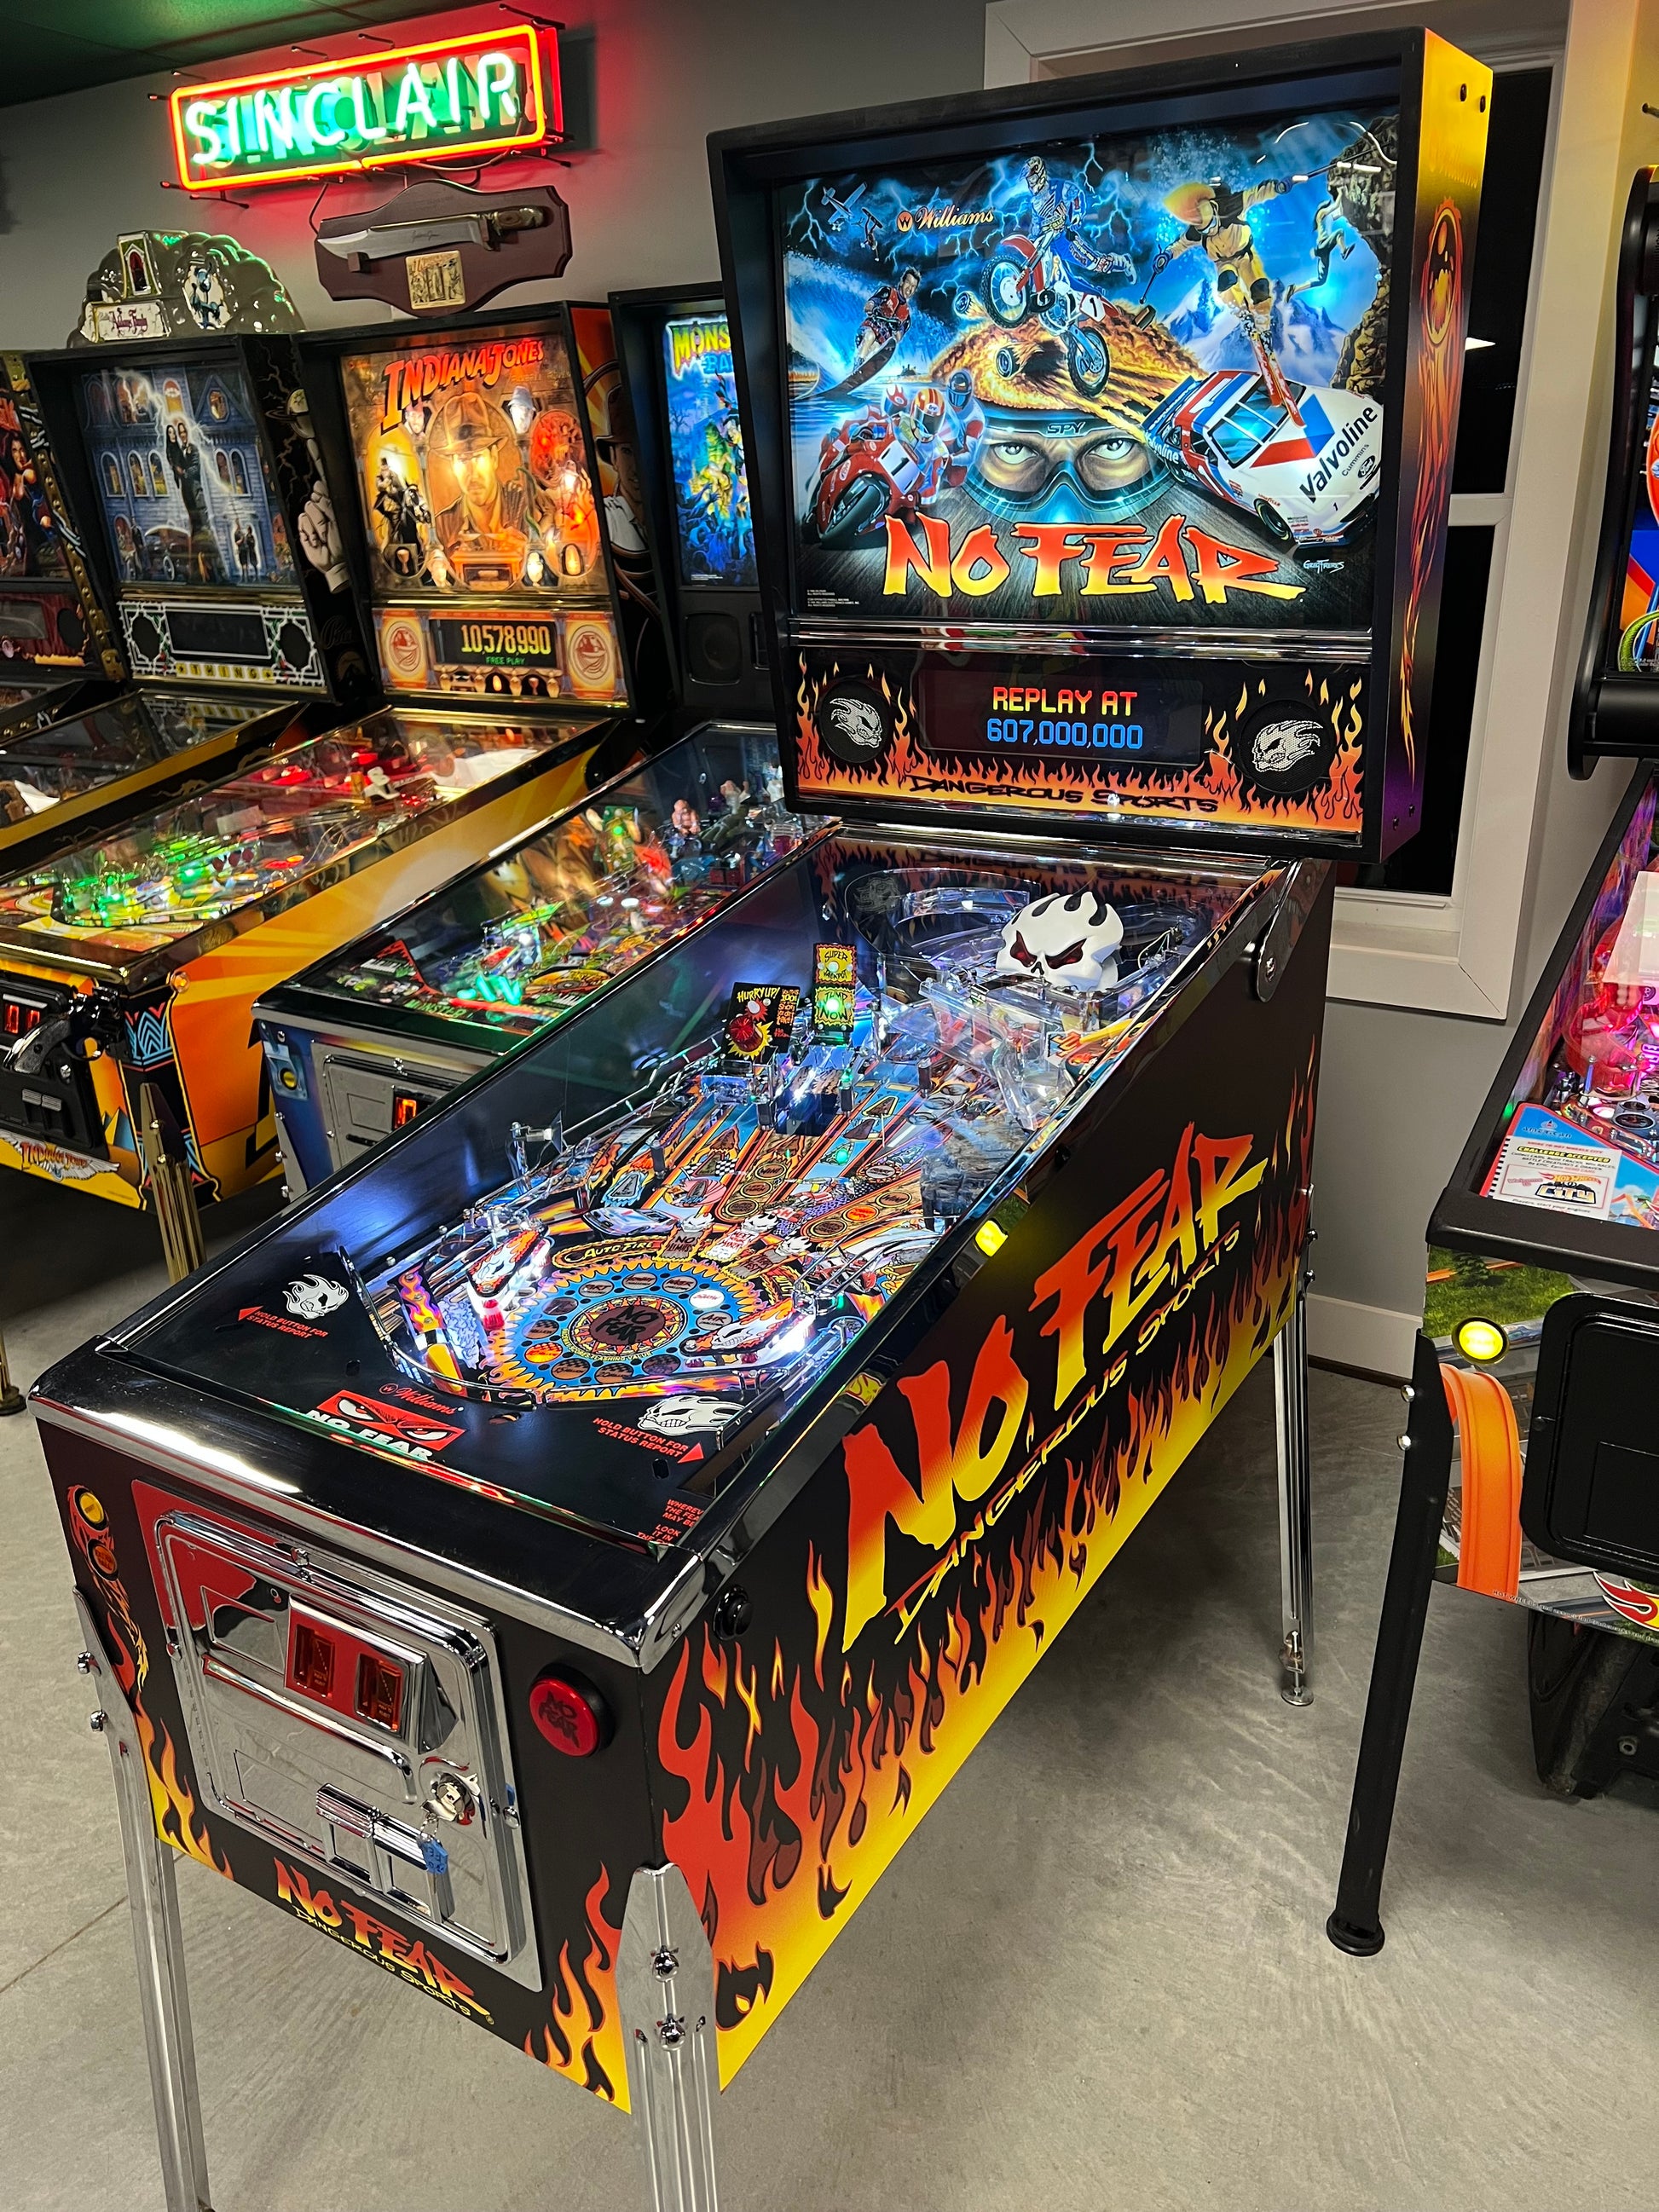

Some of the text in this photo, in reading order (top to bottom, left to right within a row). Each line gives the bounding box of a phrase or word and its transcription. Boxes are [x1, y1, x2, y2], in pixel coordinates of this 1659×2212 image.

[185, 53, 517, 165] SINCLAIR
[915, 205, 994, 230] Williams
[381, 339, 544, 435] INDIANA JONES
[1047, 421, 1086, 436] SPY
[1298, 407, 1379, 504] Valvoline
[1342, 443, 1369, 477] Cummins
[883, 511, 1307, 604] NO FEAR
[461, 624, 552, 656] 10,578,990
[486, 656, 526, 666] FREE PLAY
[992, 686, 1138, 717] REPLAY AT
[986, 718, 1143, 750] 607,000,000
[905, 774, 1219, 812] DANGEROUS SPORTS
[824, 950, 849, 963] SUPER
[737, 987, 764, 1003] HURRY
[764, 986, 781, 999] UP!
[819, 1004, 848, 1020] NOW
[1518, 1146, 1610, 1164] CHALLENGE ACCEPTED
[1538, 1184, 1595, 1203] CITY
[584, 1245, 625, 1260] AUTO
[674, 1235, 696, 1244] NO
[246, 1314, 313, 1339] STATUS REPORT
[254, 1310, 329, 1337] HOLD BUTTON FOR
[617, 1304, 660, 1323] NO
[597, 1317, 646, 1345] FEAR
[396, 1386, 459, 1415] Williams
[841, 1314, 1029, 1654] NO
[1027, 1121, 1269, 1412] FEAR
[304, 1408, 433, 1461] NO FEAR
[592, 1418, 690, 1453] HOLD BUTTON FOR
[598, 1427, 684, 1458] STATUS REPORT
[662, 1511, 697, 1528] MAY BE
[664, 1505, 685, 1516] THE
[651, 1530, 664, 1539] IT
[663, 1533, 674, 1542] IN
[655, 1524, 682, 1538] LOOK
[274, 1857, 491, 2017] NO FEAR
[290, 1902, 471, 2016] DANGEROUS SPORTS
